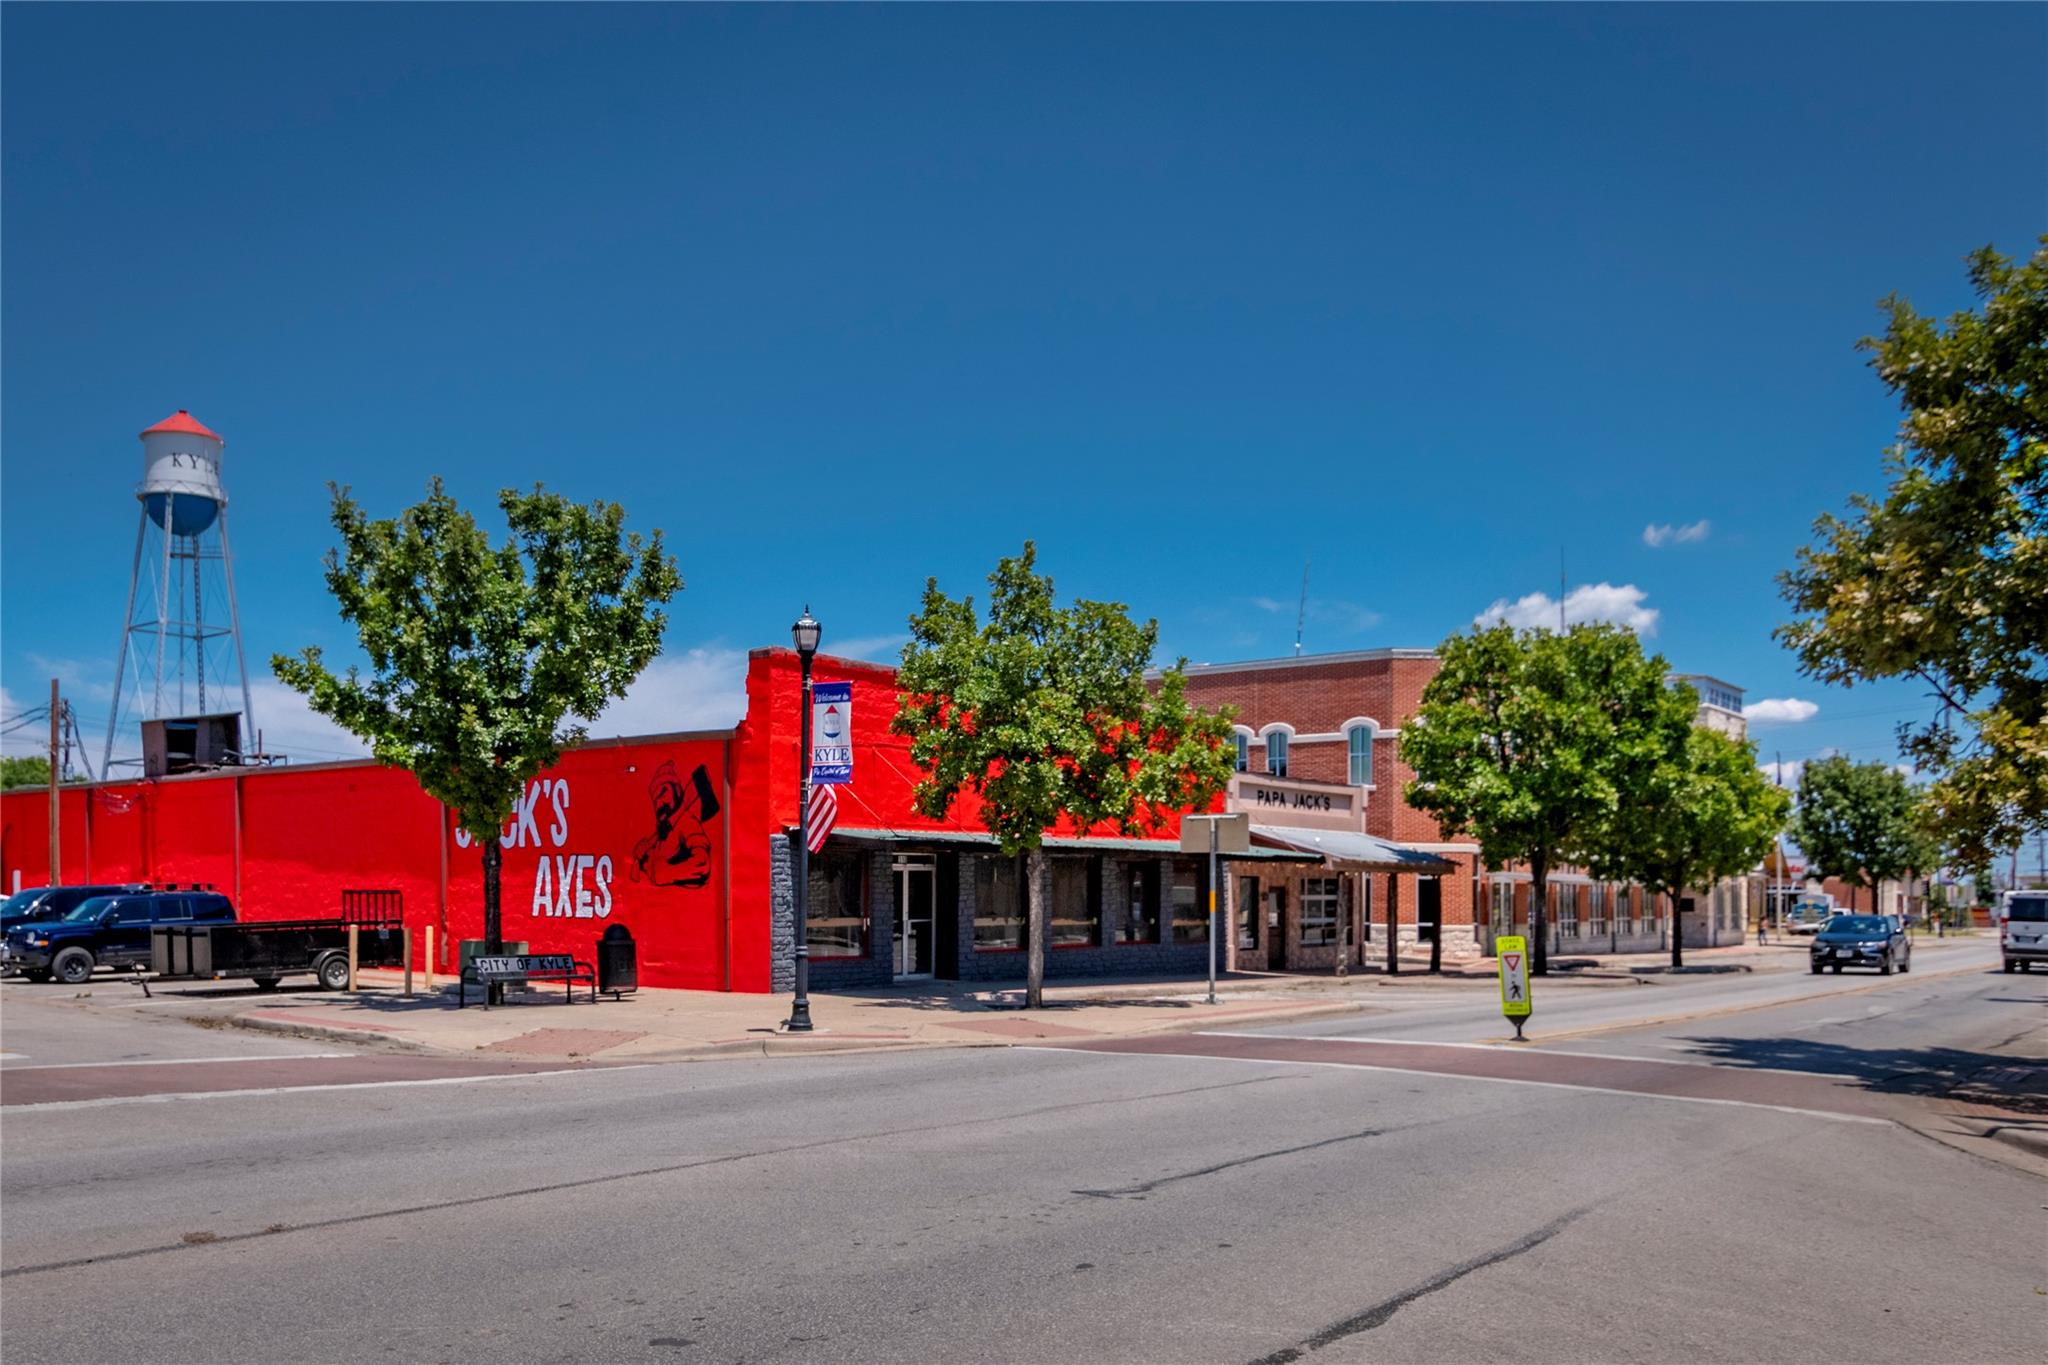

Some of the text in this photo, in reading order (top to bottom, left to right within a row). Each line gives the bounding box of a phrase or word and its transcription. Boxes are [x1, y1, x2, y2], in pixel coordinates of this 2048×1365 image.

[814, 747, 850, 762] KYLE
[1257, 789, 1332, 811] PAPA JACK'S
[532, 854, 614, 919] AXES
[480, 957, 571, 972] CITY OF KYLE
